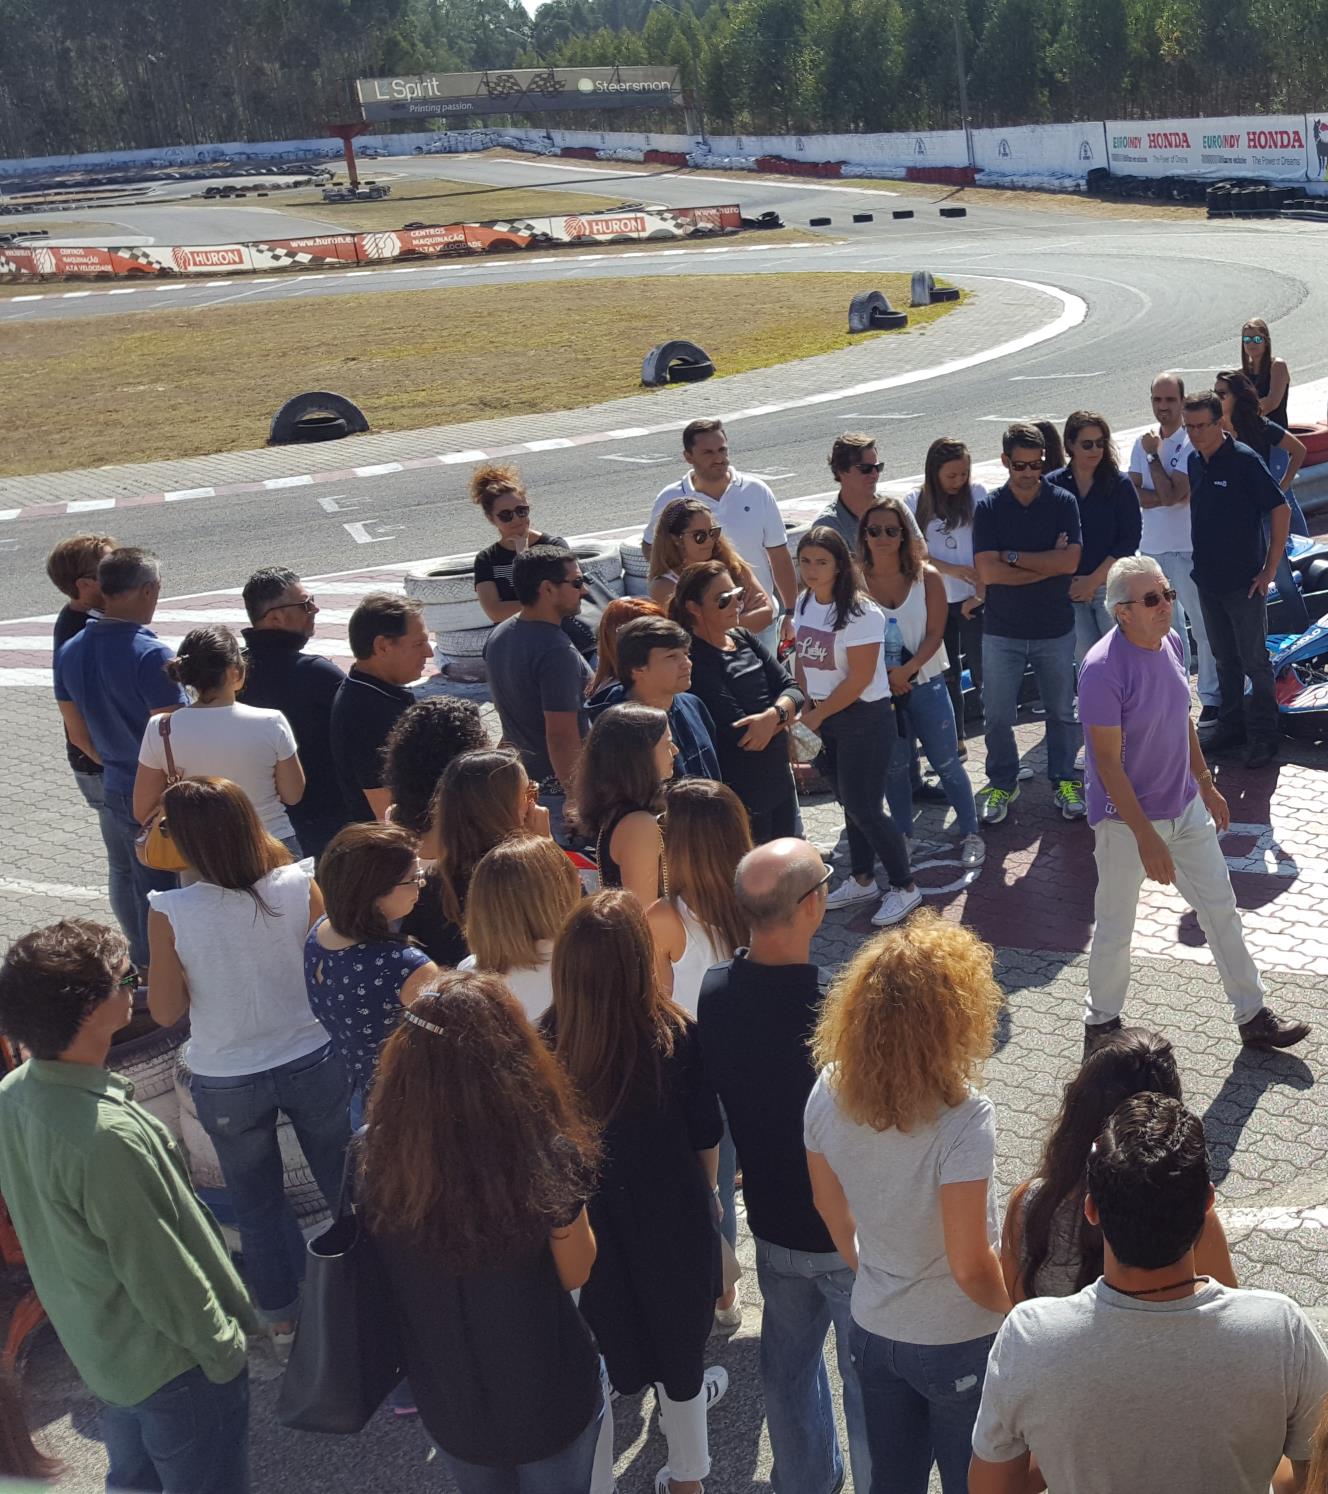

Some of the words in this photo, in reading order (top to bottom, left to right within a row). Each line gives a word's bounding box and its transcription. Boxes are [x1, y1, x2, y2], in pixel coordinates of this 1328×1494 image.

[392, 77, 441, 102] Spirit
[595, 80, 671, 93] Steersman
[409, 104, 441, 113] Printing
[1147, 132, 1191, 149] HONDA
[1246, 130, 1305, 150] HONDA
[410, 227, 446, 238] CENTROS
[592, 218, 641, 234] HURON
[193, 251, 240, 266] HURON
